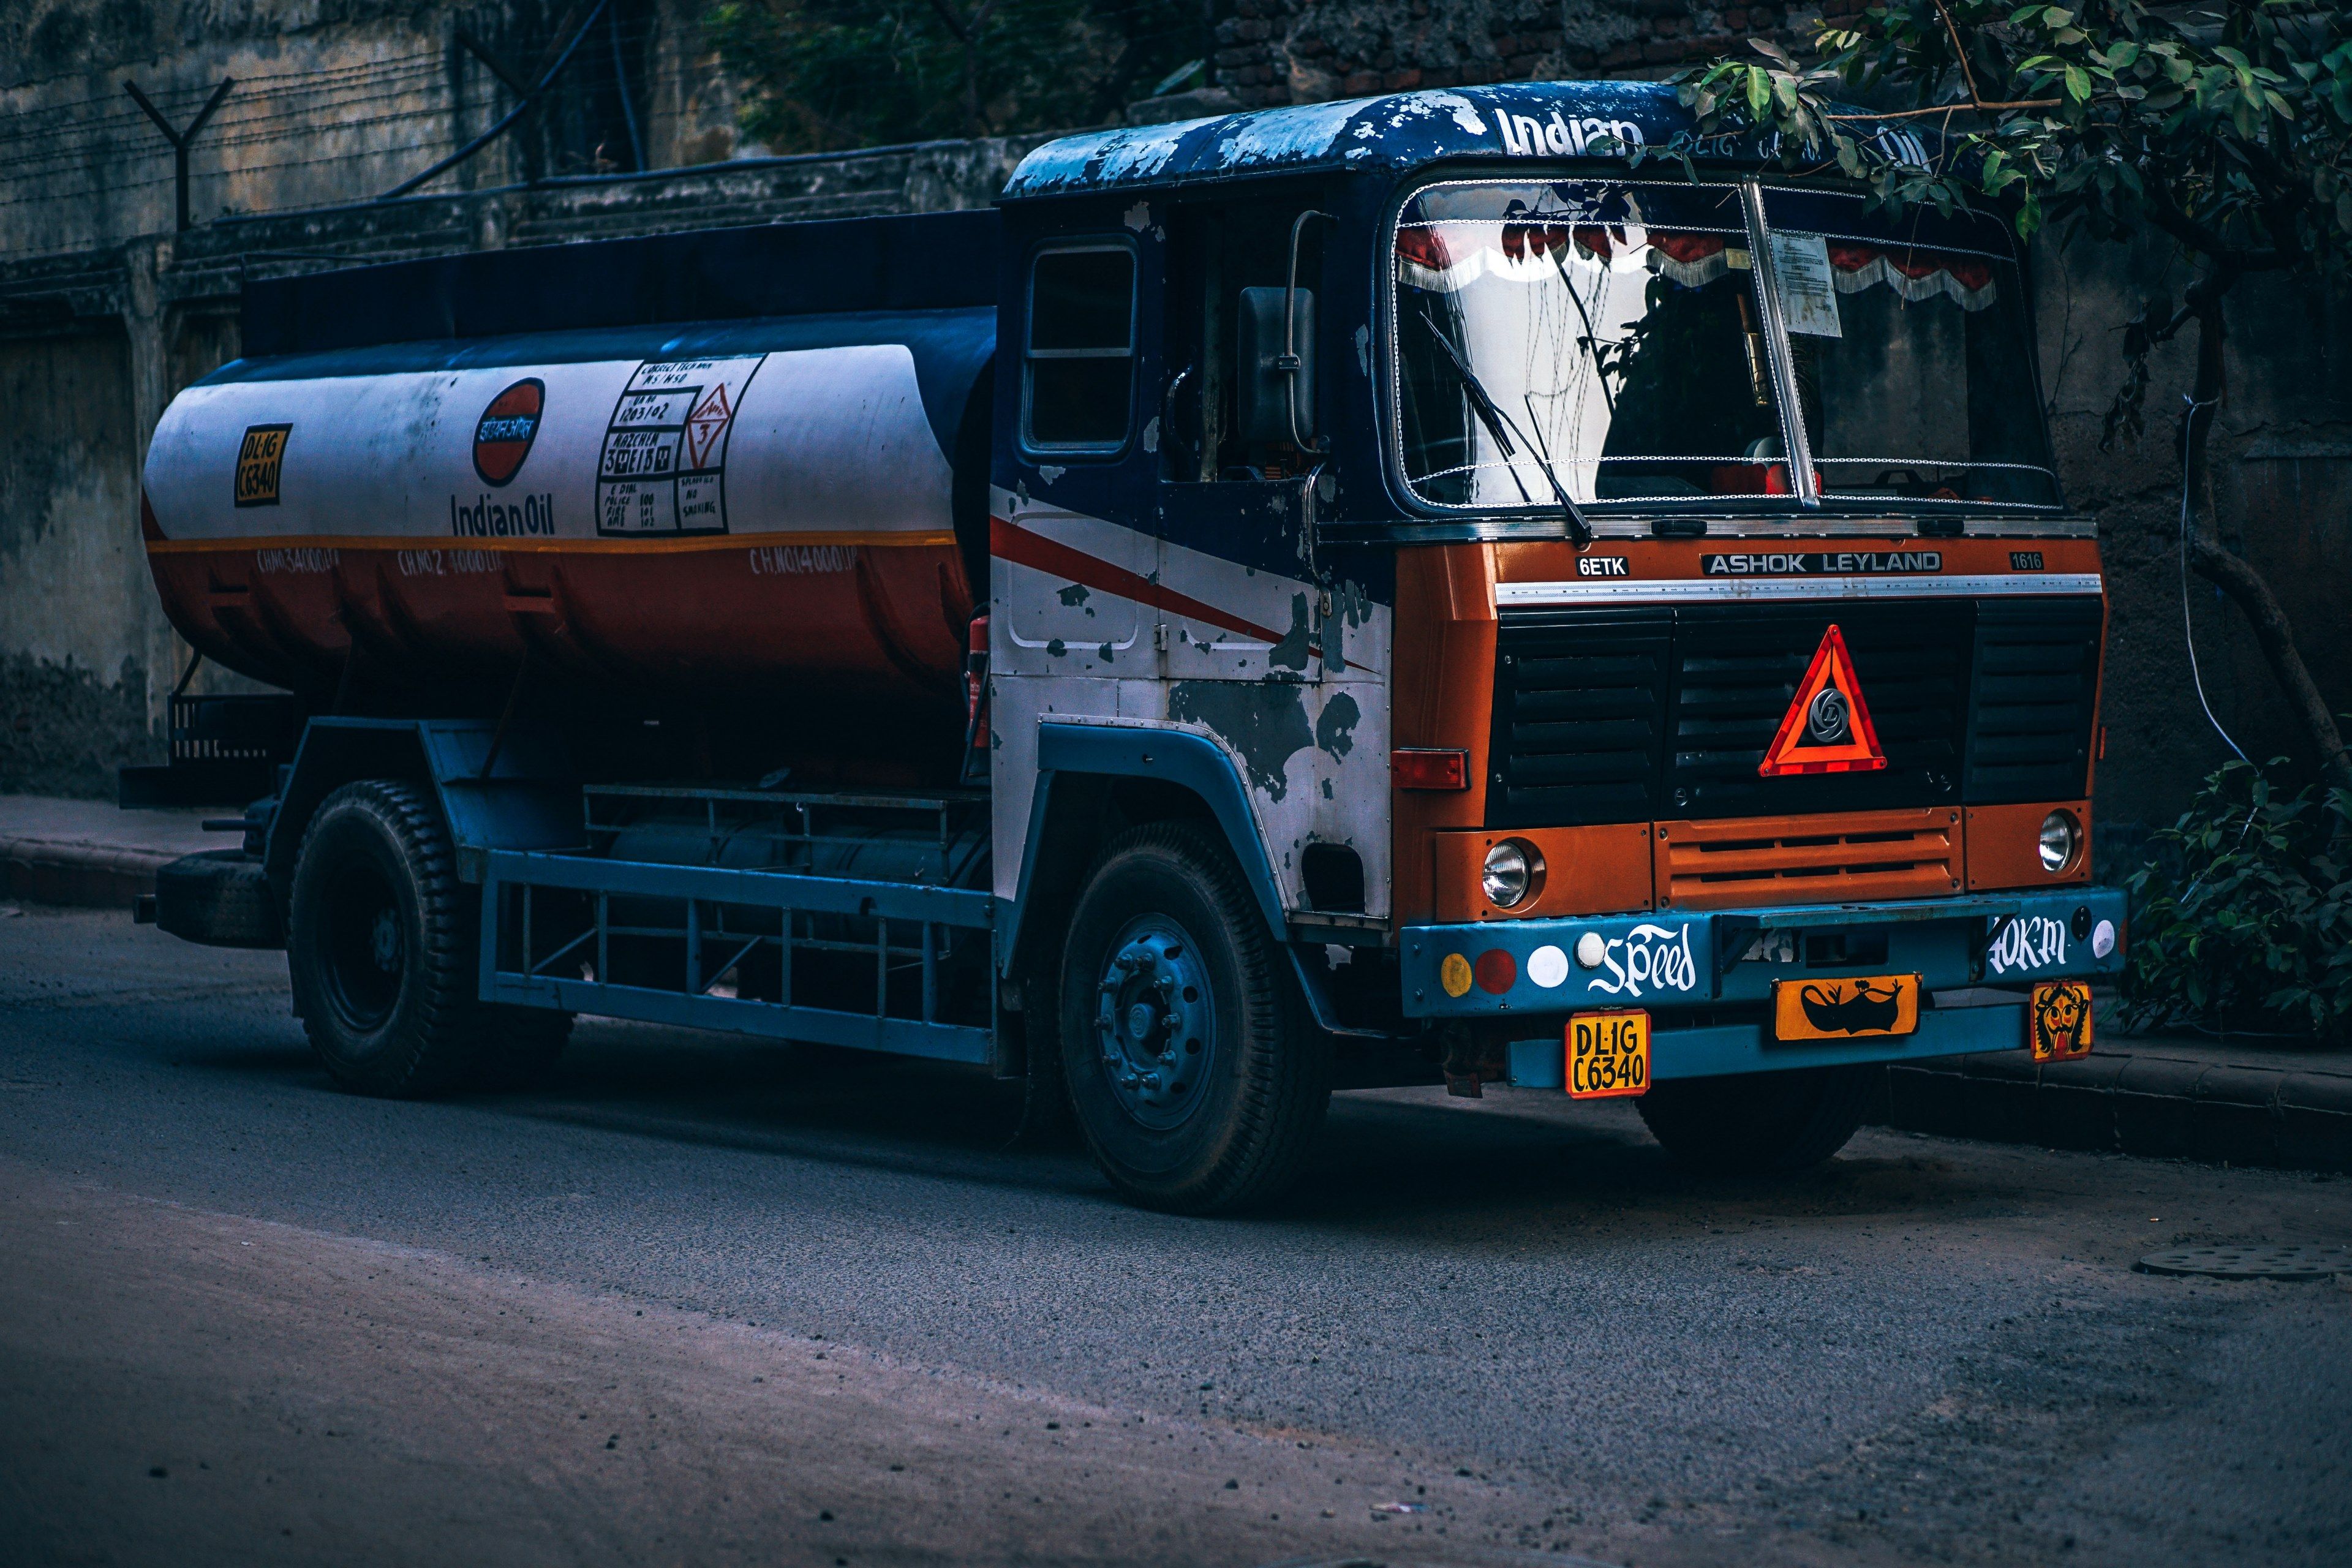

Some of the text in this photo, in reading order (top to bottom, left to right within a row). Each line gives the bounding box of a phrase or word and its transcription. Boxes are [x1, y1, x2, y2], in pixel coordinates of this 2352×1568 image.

[1494, 108, 1646, 156] Indian
[612, 432, 660, 448] HAZCHEM
[619, 483, 637, 494] DIAL
[685, 489, 698, 500] NO
[604, 493, 654, 507] POLICE 100
[606, 506, 654, 518] FIRE 101
[682, 500, 716, 517] SMOKING
[641, 517, 655, 528] 102
[1579, 557, 1625, 576] 6ETK
[1709, 552, 1940, 574] ASHOK LEYLAND
[2012, 552, 2041, 569] 1616
